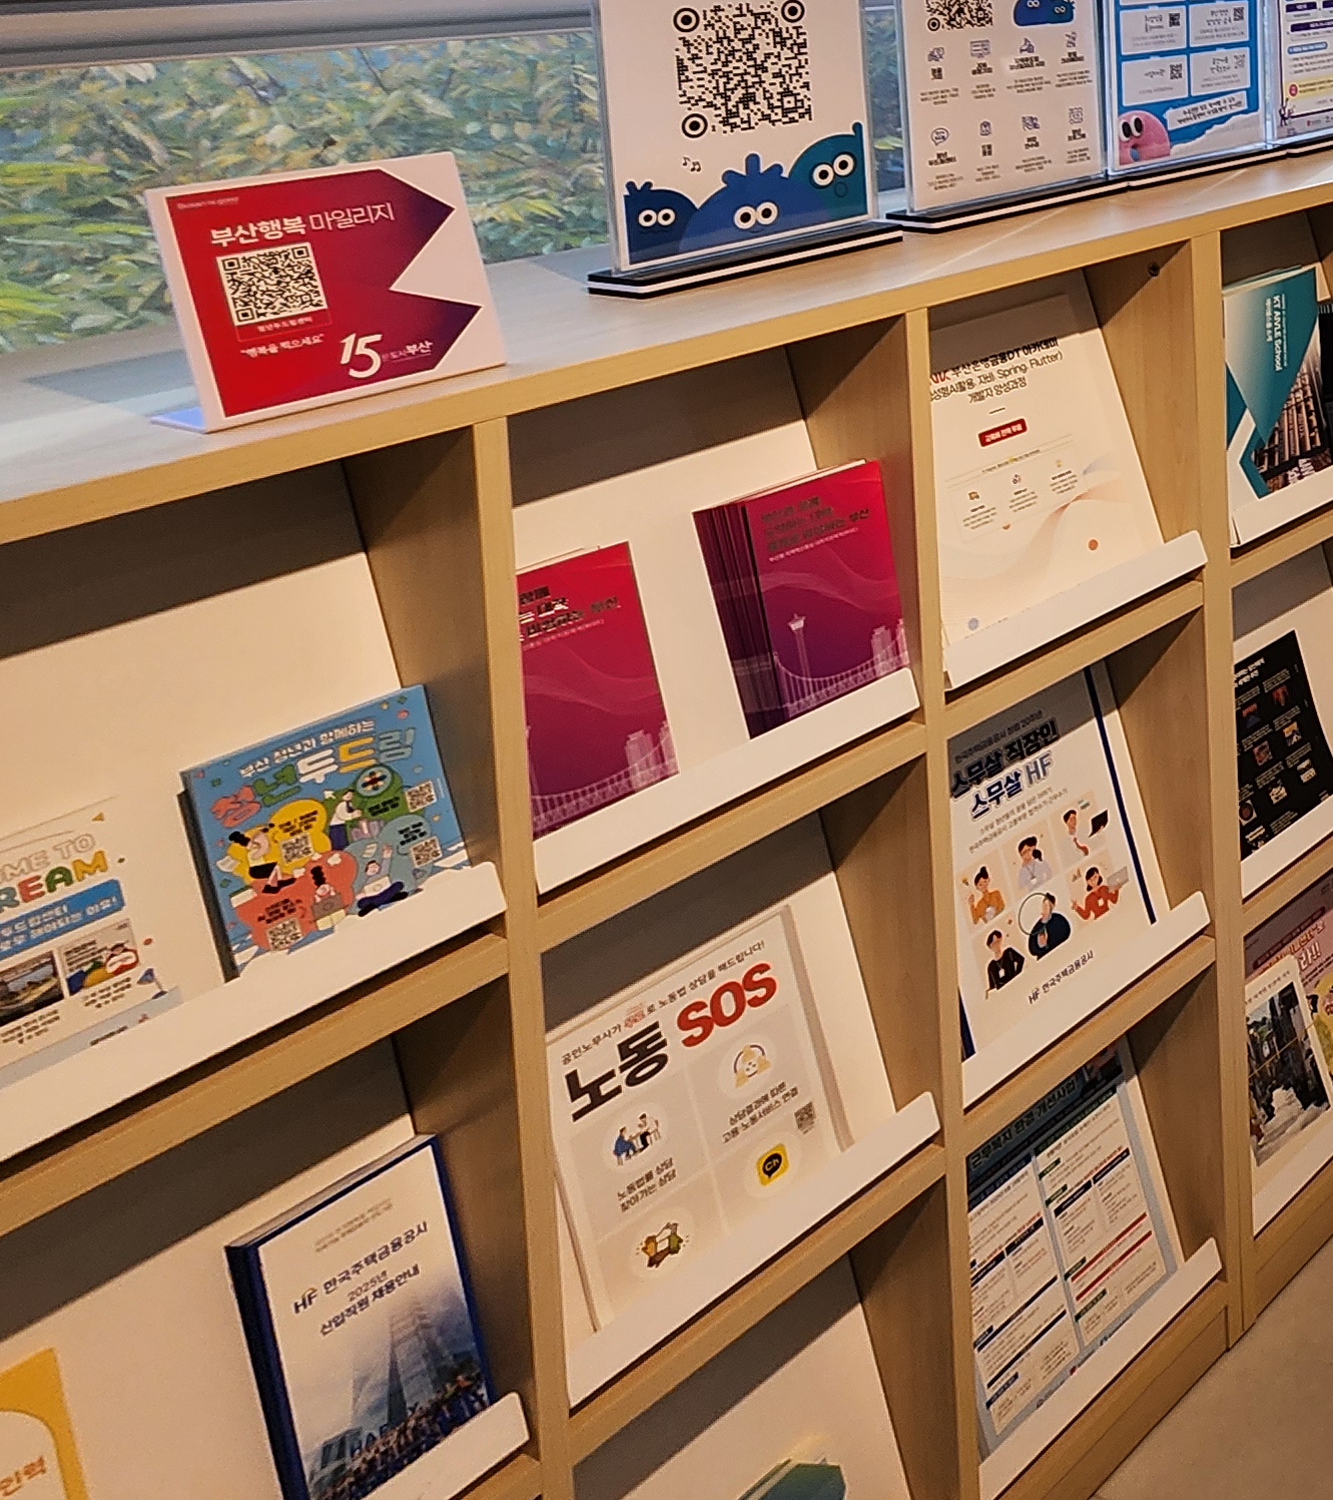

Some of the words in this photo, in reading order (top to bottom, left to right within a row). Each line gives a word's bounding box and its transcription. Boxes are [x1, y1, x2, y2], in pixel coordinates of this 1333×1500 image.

[210, 215, 307, 248] 부산행복
[308, 201, 396, 232] 마일리지
[405, 339, 434, 358] 부산
[239, 755, 270, 780] 부산
[273, 740, 316, 763] 청년과
[952, 750, 1003, 799] 스무살
[1004, 719, 1058, 761] 직장인
[972, 770, 1023, 820] 스무살
[1025, 750, 1052, 785] HF
[561, 1023, 622, 1065] 공인노무사가
[658, 986, 687, 1008] 노동법
[688, 968, 717, 991] 상담을
[564, 1020, 669, 1123] 노동
[676, 962, 778, 1048] SOS
[294, 1291, 318, 1314] HF
[323, 1220, 428, 1295] 한국주택금융공사
